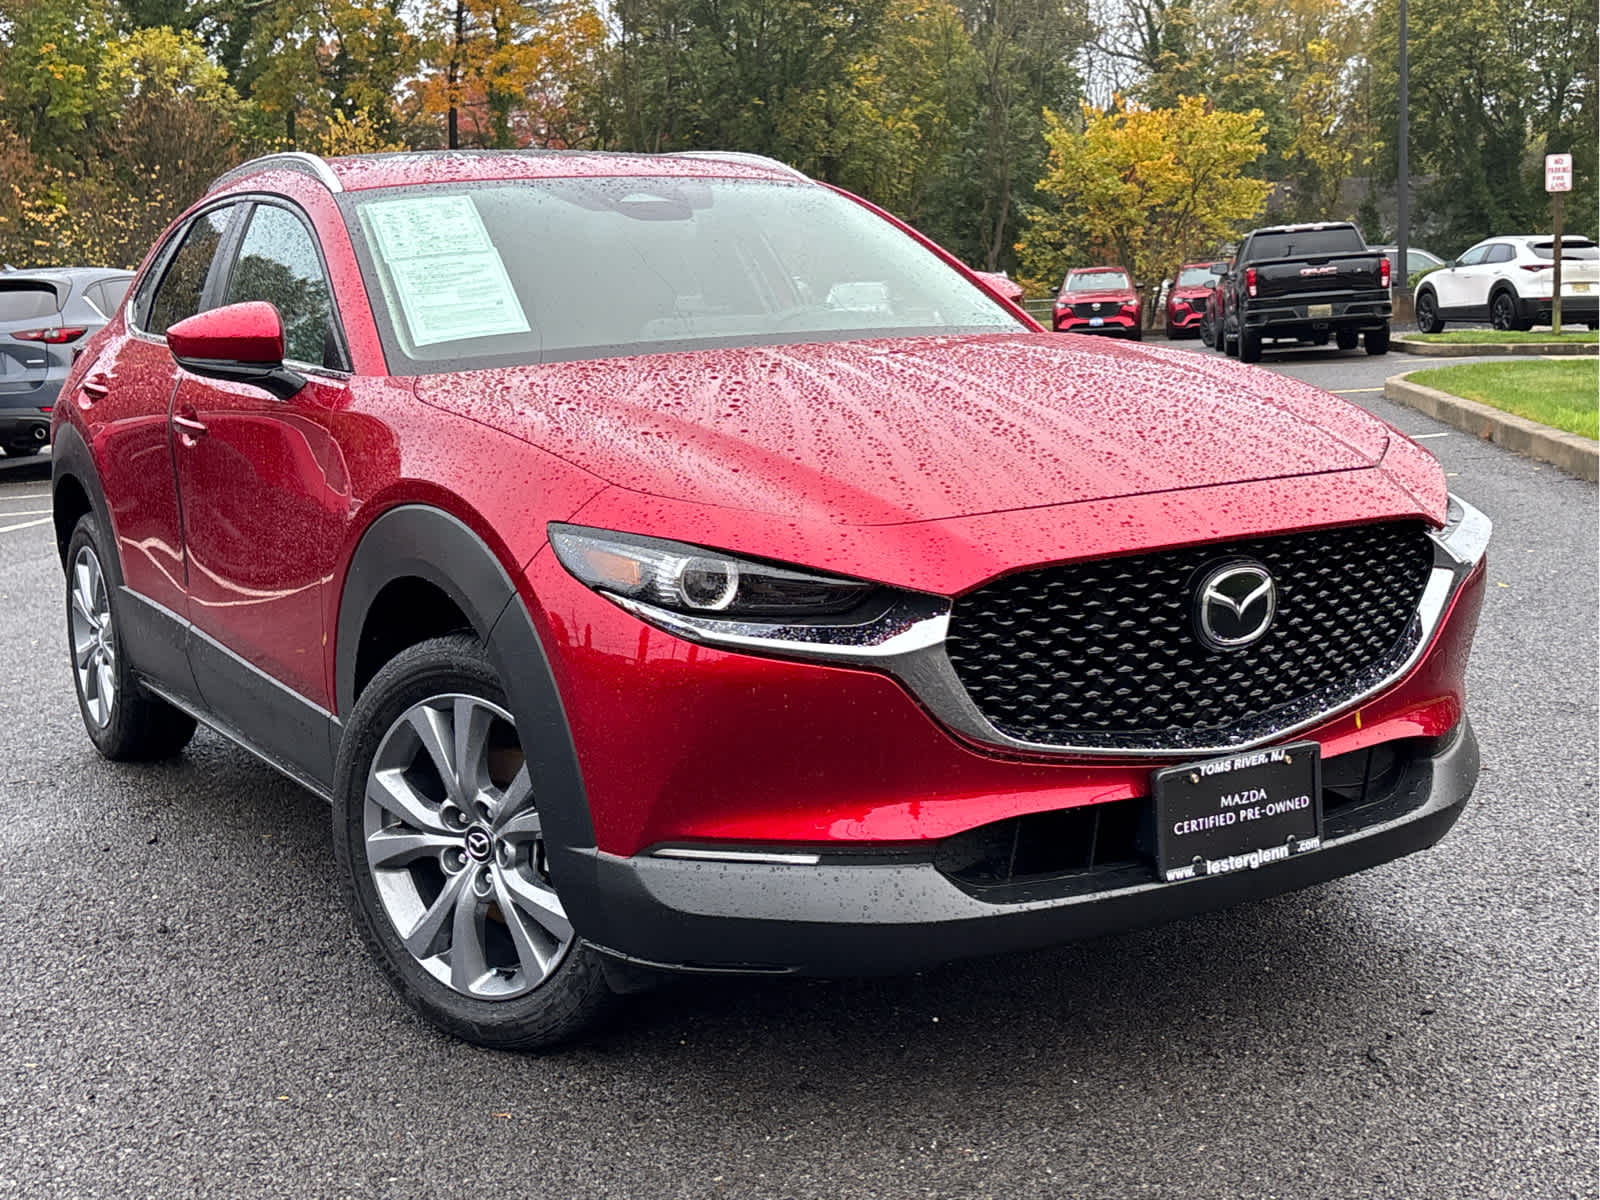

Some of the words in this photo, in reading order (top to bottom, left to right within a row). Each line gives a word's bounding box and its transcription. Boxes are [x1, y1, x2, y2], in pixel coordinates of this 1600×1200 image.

[1299, 266, 1338, 278] GMC
[1199, 760, 1232, 777] TOMS
[1270, 750, 1286, 763] NJ
[1220, 788, 1268, 808] MAZDA
[1174, 813, 1236, 835] CERTIFIED
[1239, 796, 1310, 822] PRE-OWNED
